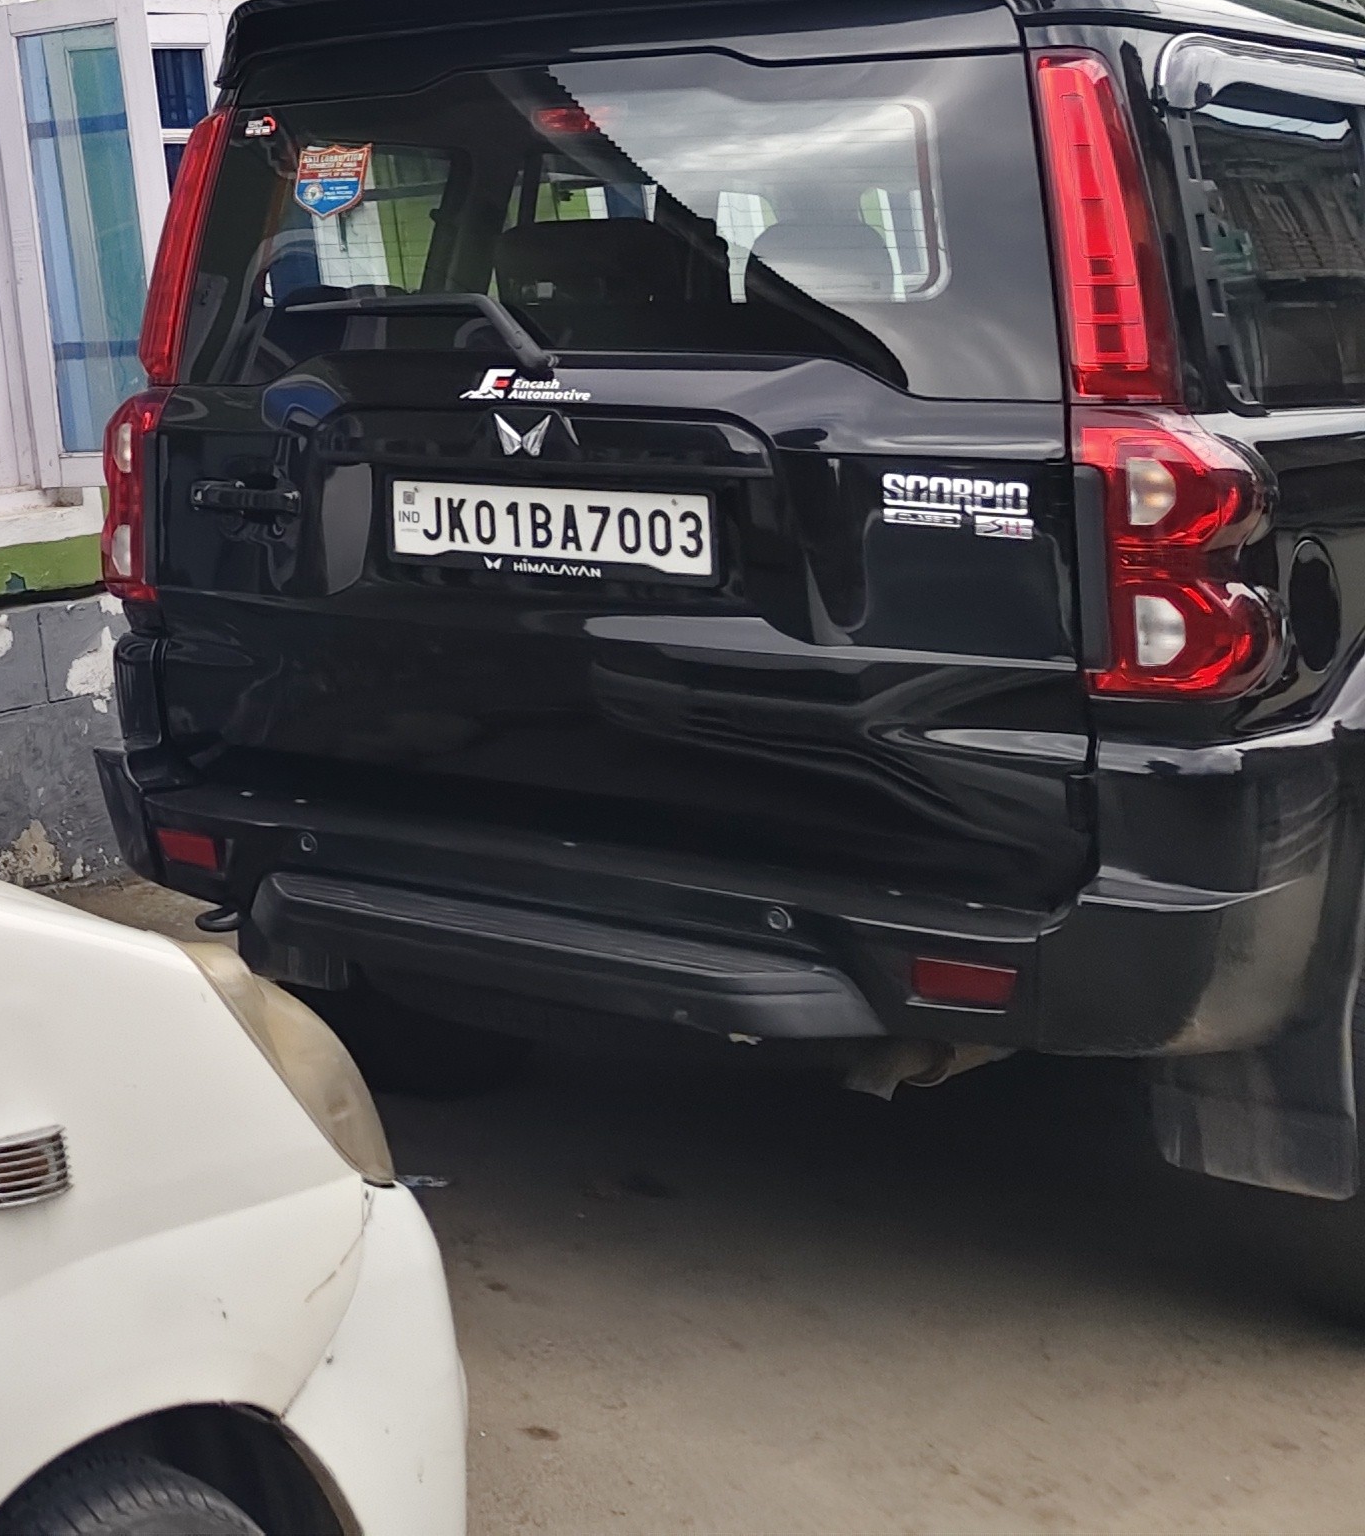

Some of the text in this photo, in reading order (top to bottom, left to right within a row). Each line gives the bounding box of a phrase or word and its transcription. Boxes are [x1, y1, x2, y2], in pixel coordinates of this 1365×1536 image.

[512, 378, 560, 389] Encash
[507, 389, 591, 401] Automotive
[882, 473, 1029, 516] SCORPIO
[398, 510, 420, 523] IND
[422, 496, 704, 558] JK01BA7003
